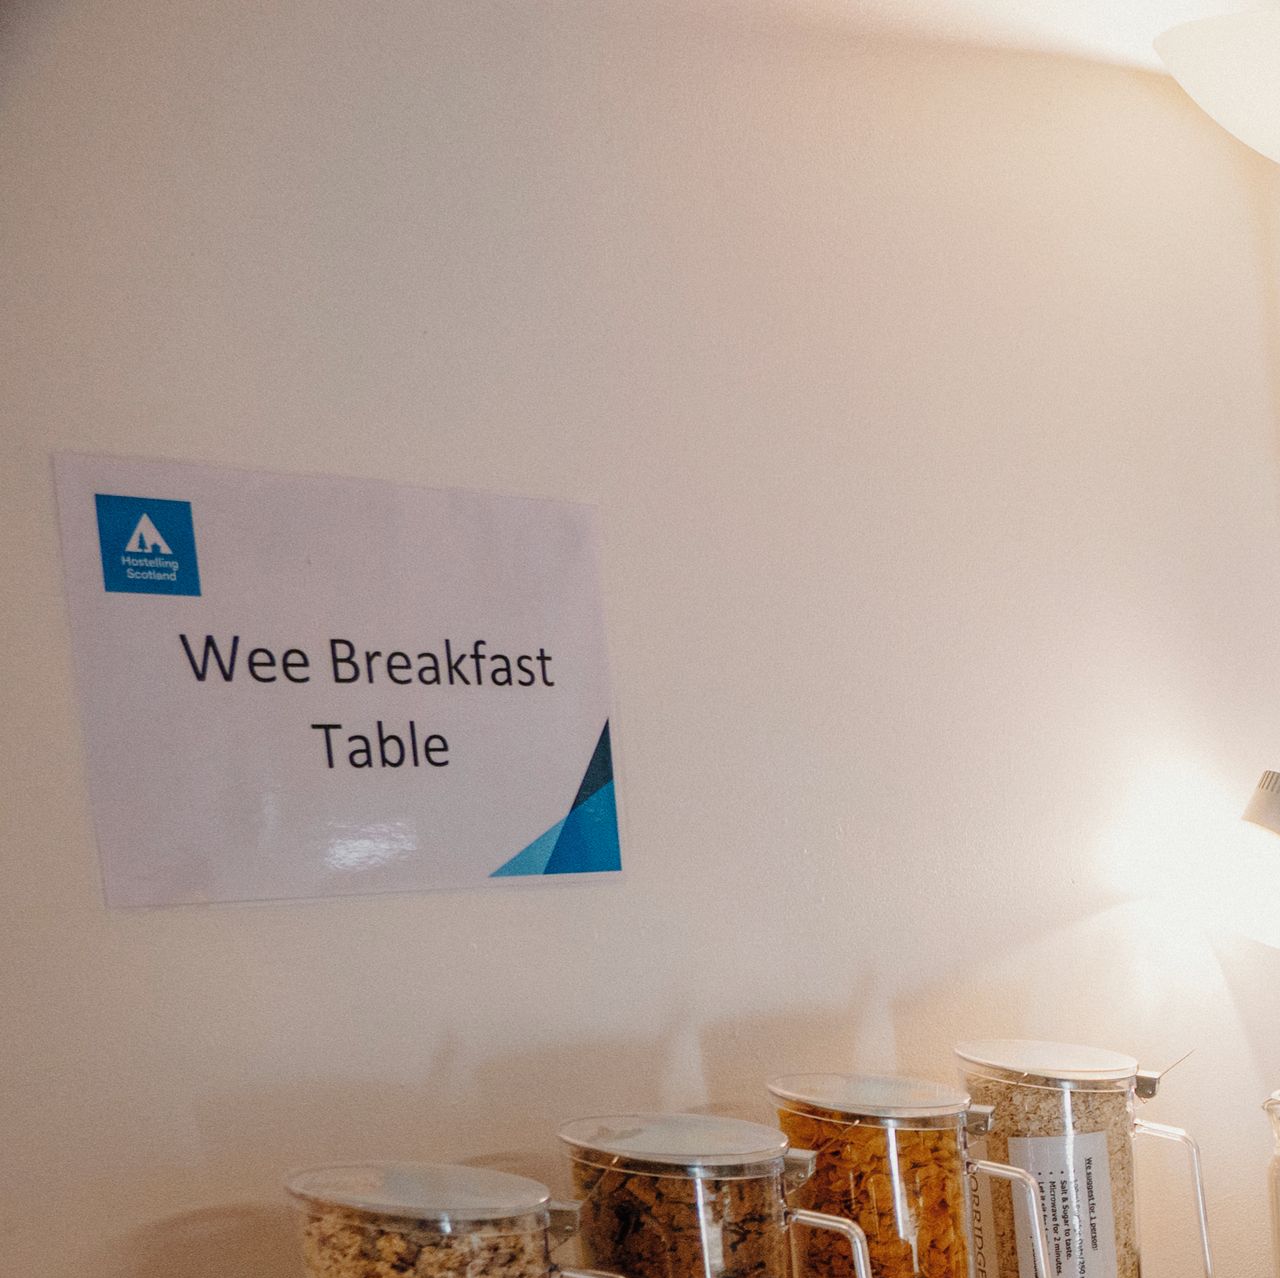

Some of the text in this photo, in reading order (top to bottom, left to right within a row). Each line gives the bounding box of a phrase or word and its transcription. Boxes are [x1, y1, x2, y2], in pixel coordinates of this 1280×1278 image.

[120, 556, 180, 572] Hostelling
[126, 569, 178, 582] Scotland
[179, 632, 556, 688] Wee Breakfast
[310, 720, 451, 769] Table
[1085, 1157, 1093, 1171] We
[1060, 1180, 1068, 1195] Salt
[1085, 1171, 1096, 1202] suggest
[1049, 1181, 1060, 1222] Microwave
[1061, 1204, 1070, 1227] Sugar
[1052, 1224, 1060, 1234] for
[1055, 1244, 1063, 1276] minutes.
[1065, 1238, 1073, 1260] taste.
